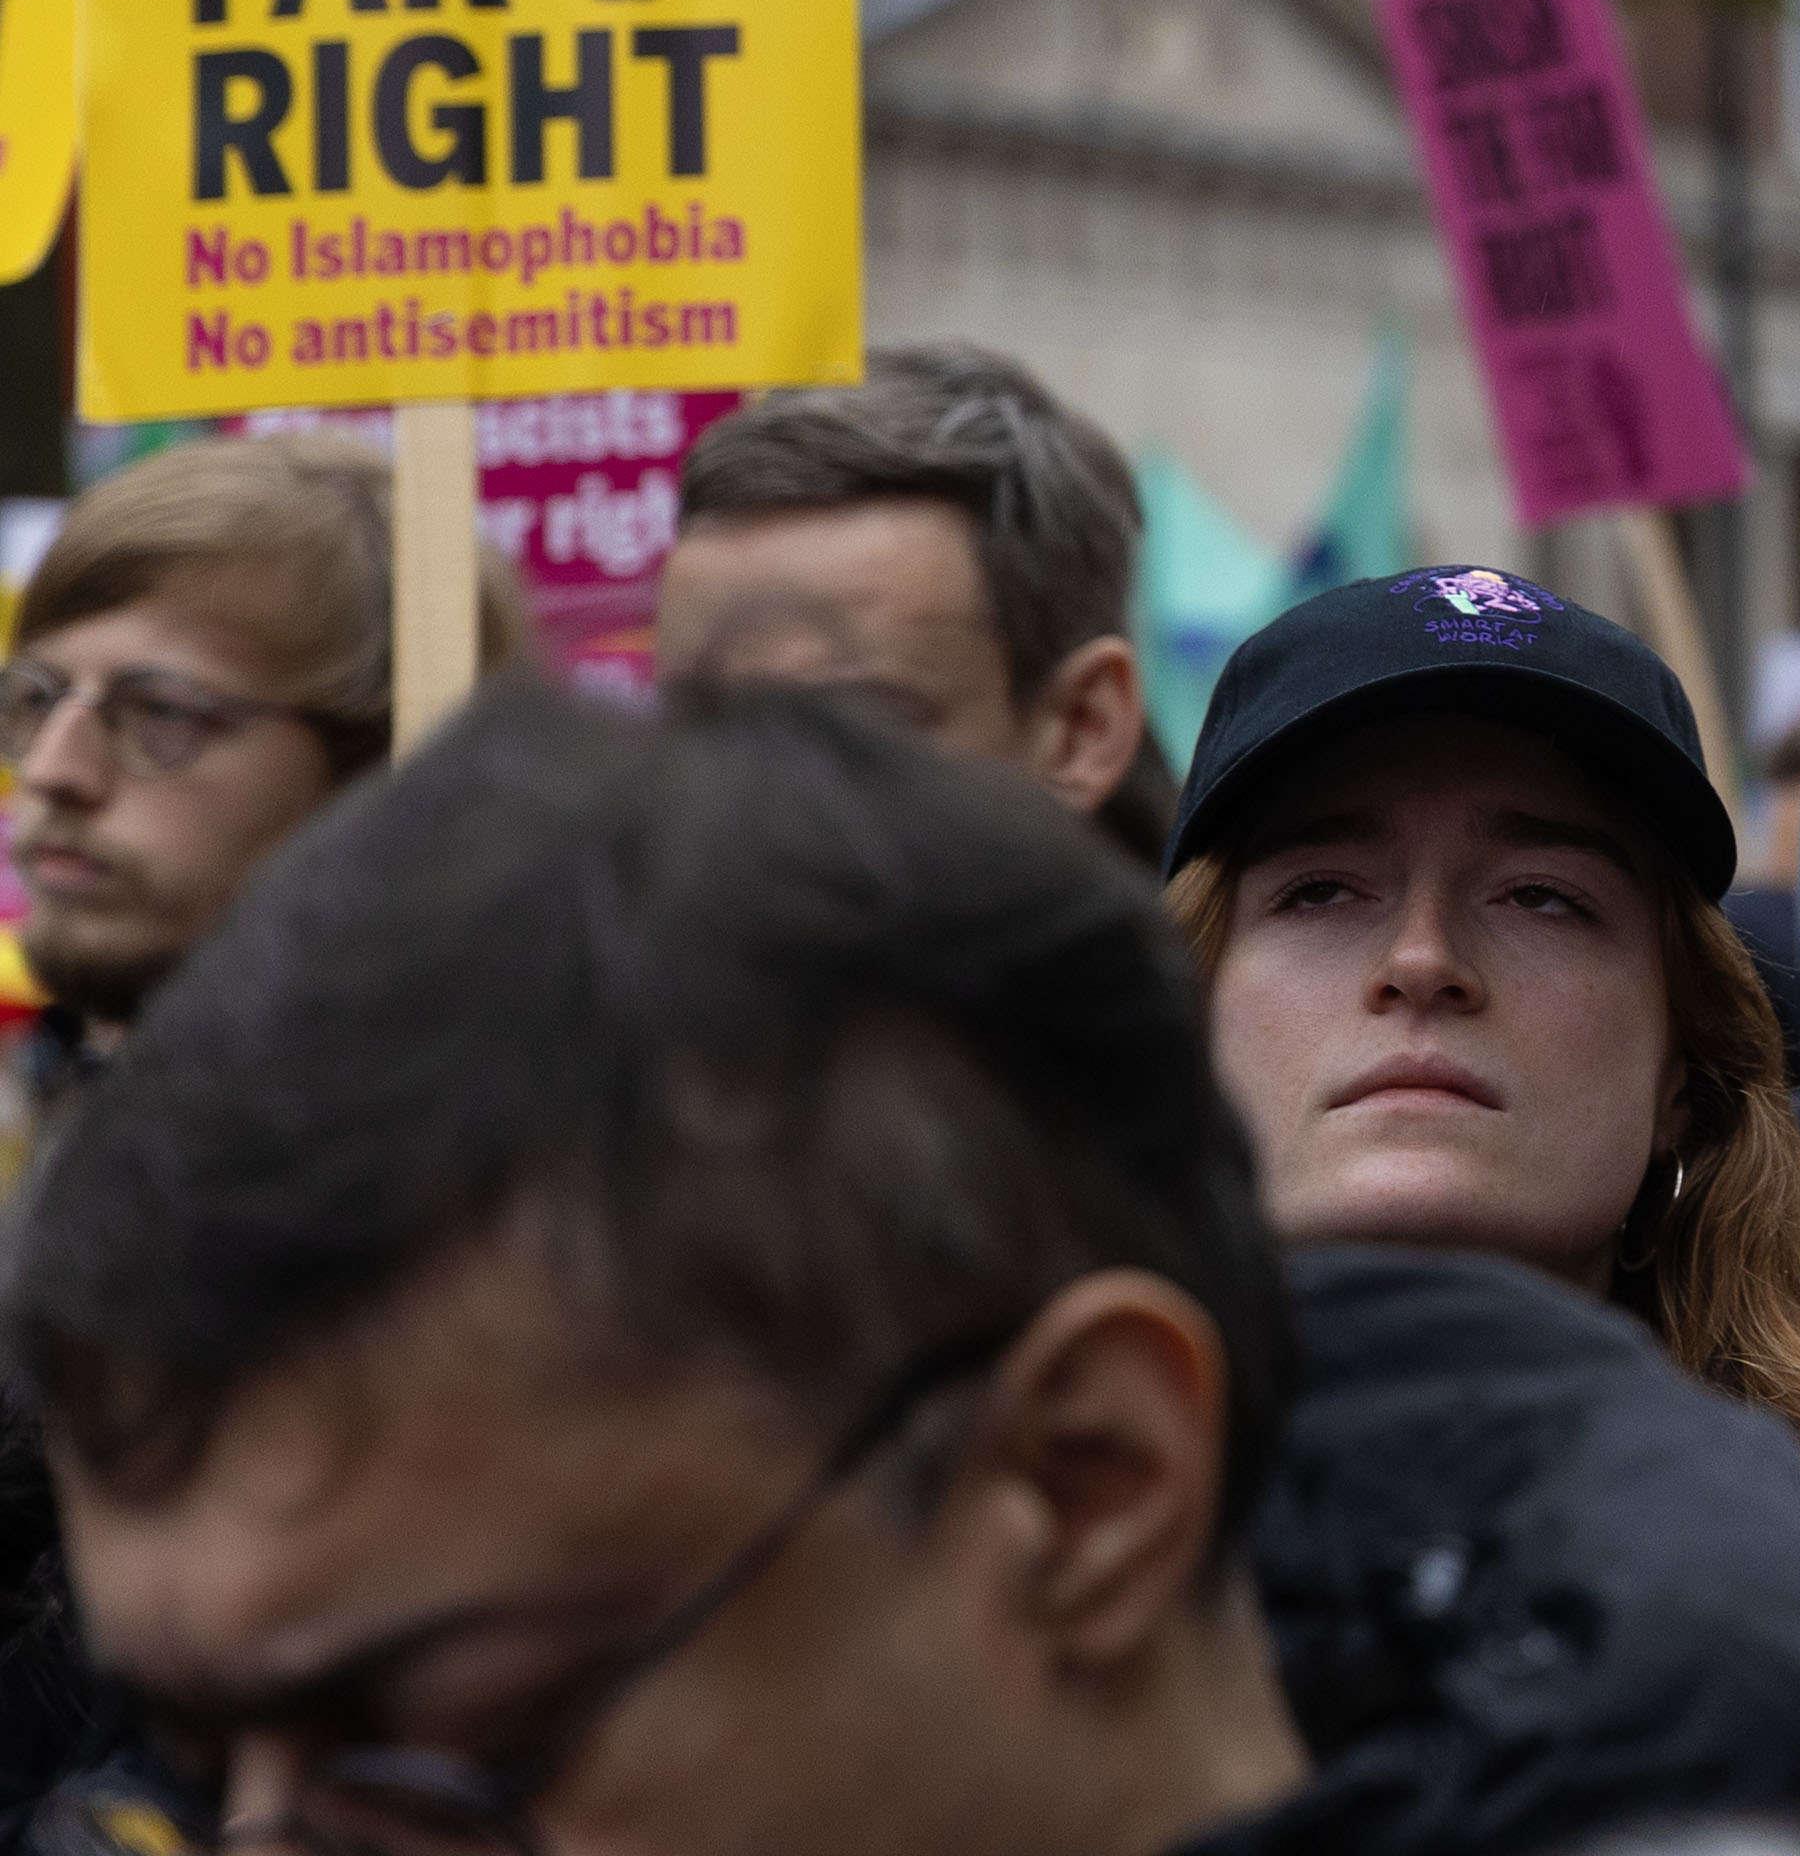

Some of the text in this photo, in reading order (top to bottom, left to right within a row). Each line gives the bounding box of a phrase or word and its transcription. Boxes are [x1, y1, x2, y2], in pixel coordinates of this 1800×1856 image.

[190, 24, 743, 202] RIGHT
[186, 200, 748, 289] No Islamophobia
[186, 287, 740, 374] No antisemitism
[1424, 618, 1538, 645] SMART AT
[1437, 631, 1520, 651] WORK
